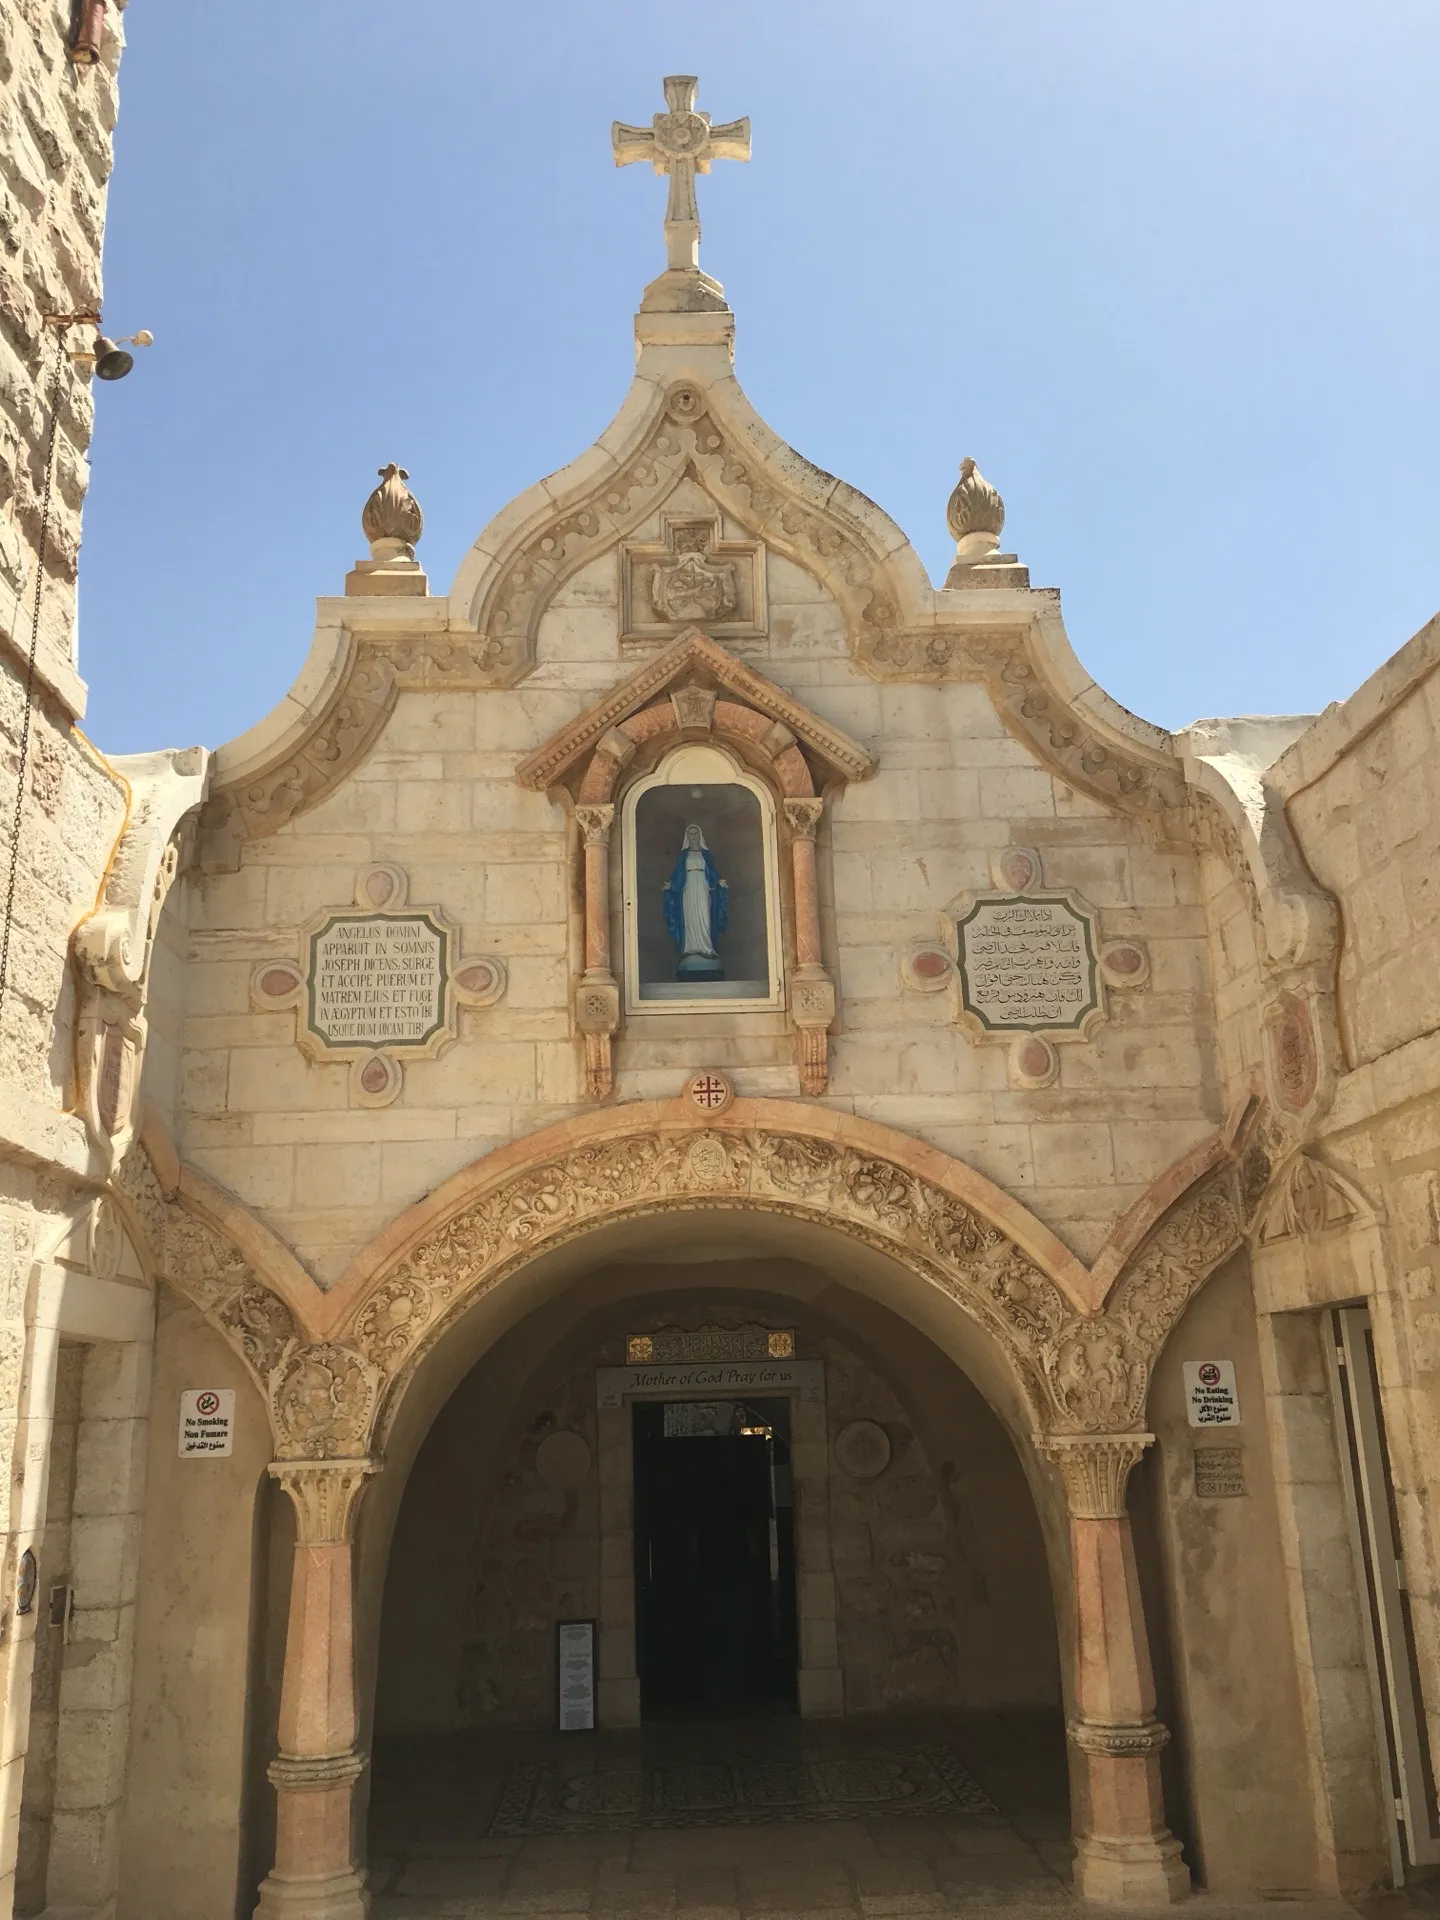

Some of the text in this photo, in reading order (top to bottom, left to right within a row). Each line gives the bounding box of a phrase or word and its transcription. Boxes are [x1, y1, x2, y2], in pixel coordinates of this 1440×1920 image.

[992, 909, 1018, 922] الرب
[336, 926, 420, 939] ANGELUS DOMINI
[322, 941, 435, 956] APPARUIT IN SOMNIS
[322, 958, 360, 971] JOSEPH
[402, 957, 434, 970] SURGE
[974, 957, 1000, 971] مصر
[322, 973, 434, 988] ET ACCIPE PUERUM ET
[321, 990, 433, 1004] MATREM EJUS ET FUGE
[320, 1008, 330, 1020] IN
[380, 1006, 392, 1019] ET
[394, 1006, 419, 1018] ESTO
[328, 1022, 424, 1037] USQUE DUM DICAM TIBI
[630, 1368, 792, 1388] Mother of God Pray for us
[1206, 1386, 1228, 1395] Eating
[1192, 1396, 1234, 1404] No Drinking
[1214, 1404, 1228, 1414] ممنوع
[186, 1418, 228, 1427] No Smoking
[1216, 1413, 1232, 1422] ممنوع
[184, 1430, 228, 1438] Non Fumare
[186, 1441, 225, 1451] ممنوع التدخين
